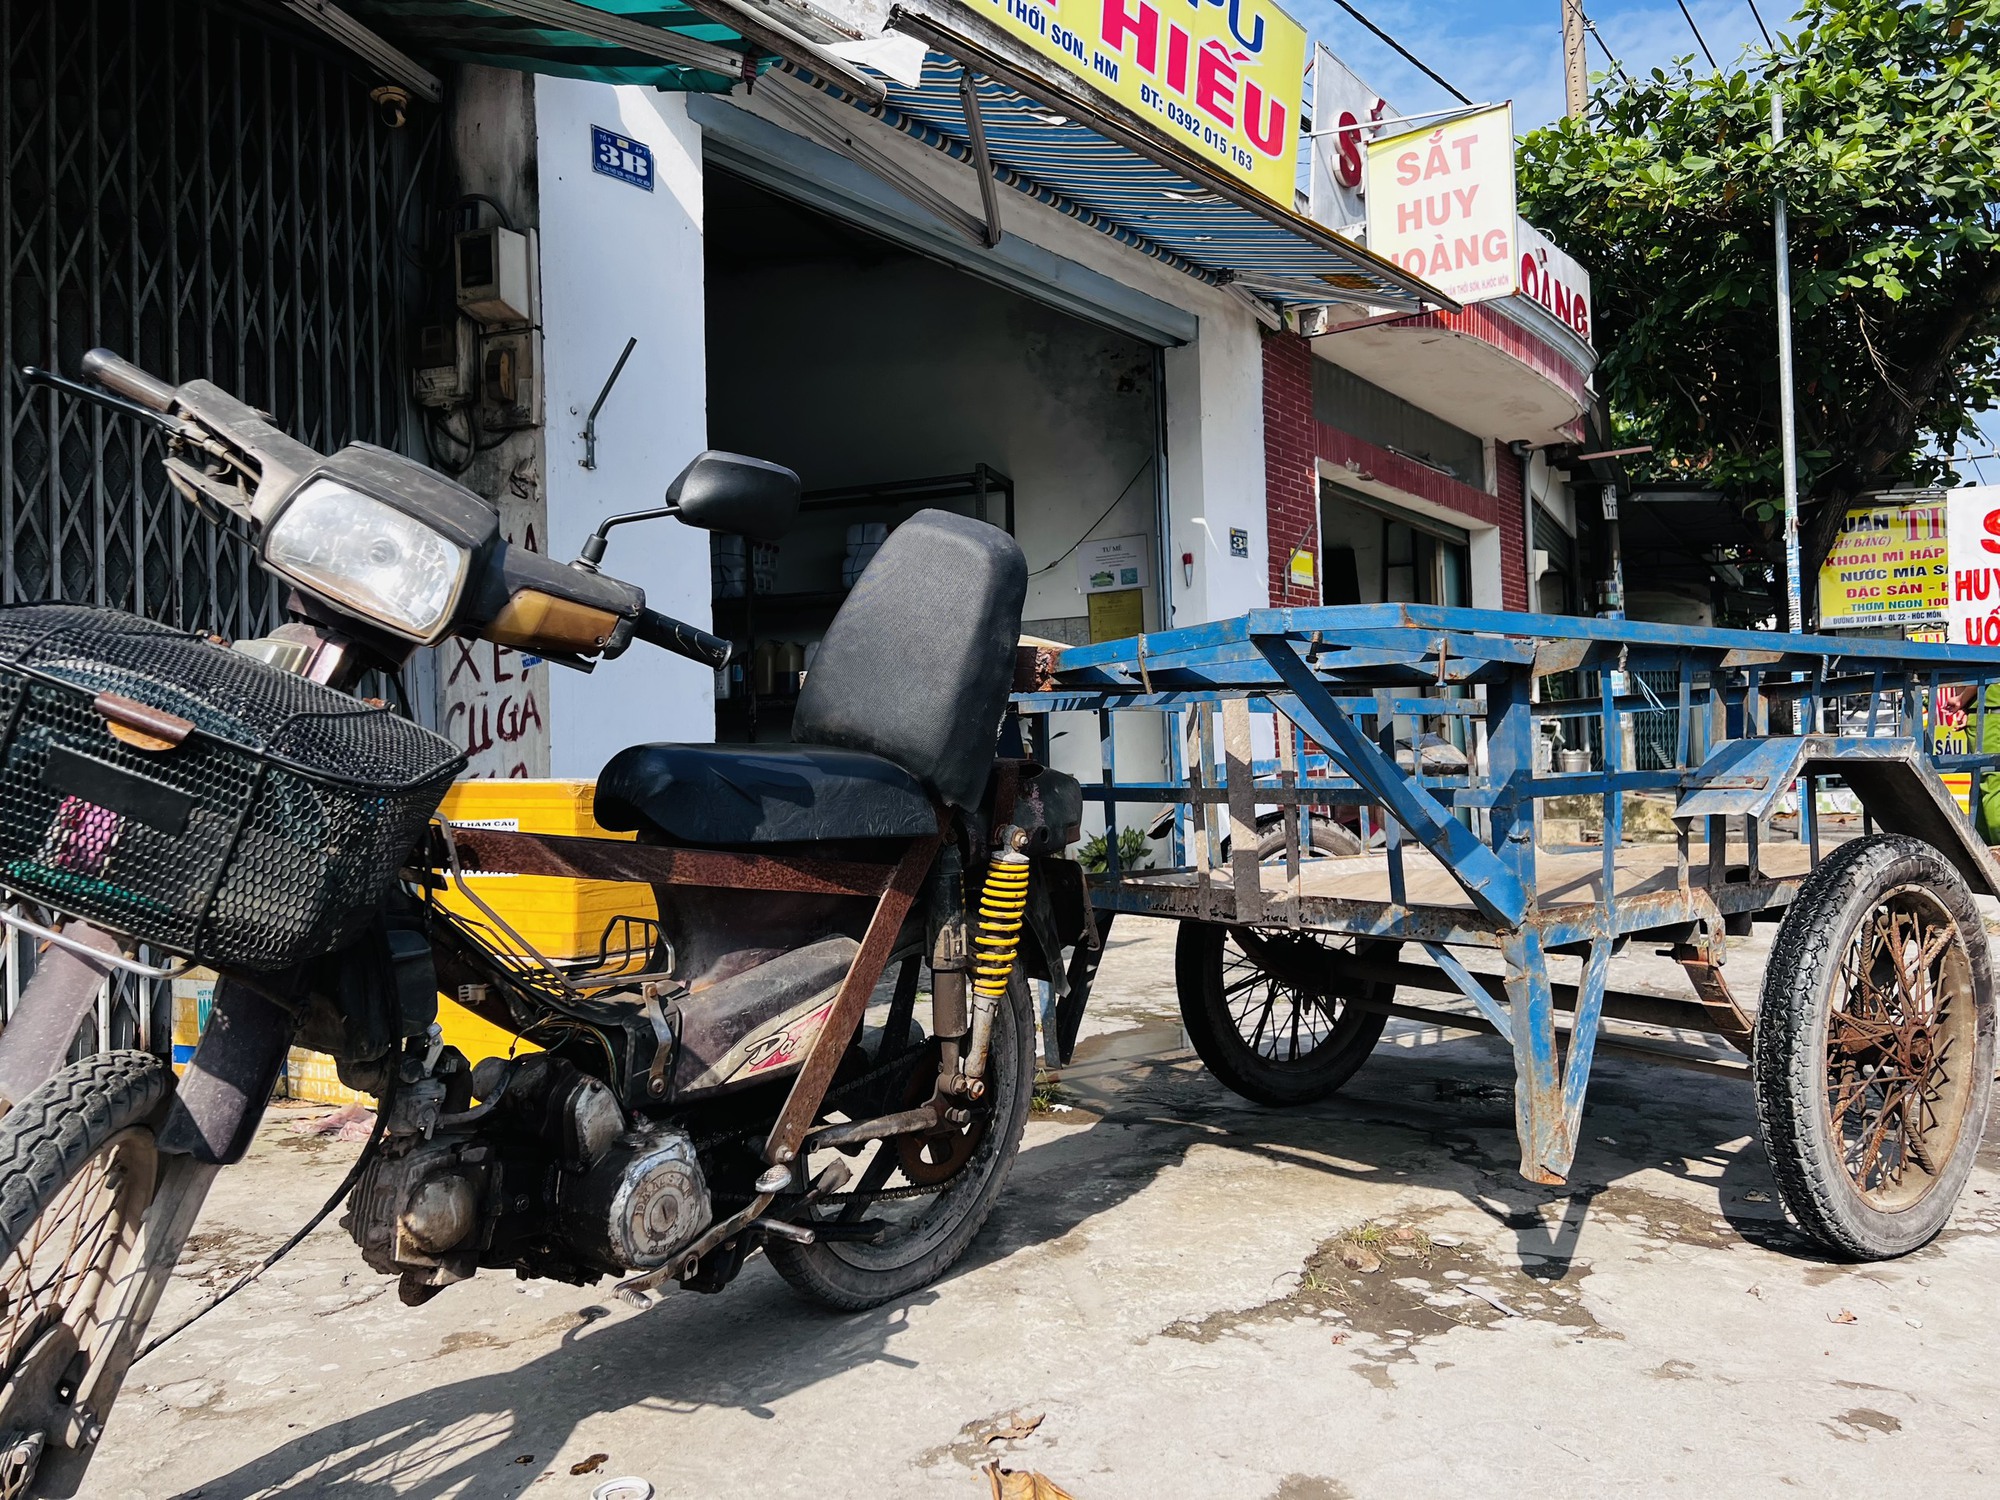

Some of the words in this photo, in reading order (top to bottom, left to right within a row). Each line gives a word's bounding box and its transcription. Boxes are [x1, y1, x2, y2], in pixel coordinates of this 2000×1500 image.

[1051, 24, 1087, 65] SƠN,
[1094, 52, 1118, 82] HM
[1102, 0, 1285, 157] HIẾU
[1141, 84, 1162, 112] ĐT:
[1168, 102, 1200, 137] 0392
[1205, 127, 1226, 153] 015
[1232, 146, 1252, 170] 163
[600, 143, 647, 177] 3B
[1396, 129, 1479, 186] SẮT
[1397, 184, 1479, 234] HUY
[1840, 513, 1889, 534] UÁN
[1826, 553, 1877, 566] KHOAI
[1841, 568, 1887, 582] NƯỚC
[1894, 565, 1927, 578] MÍA
[1934, 565, 1948, 575] S
[1846, 586, 1880, 600] ĐẶC
[1887, 581, 1922, 595] SẢN
[1851, 602, 1884, 612] THƠM
[1889, 600, 1922, 610] NGON
[1888, 614, 1896, 622] QL
[1898, 613, 1905, 621] 22
